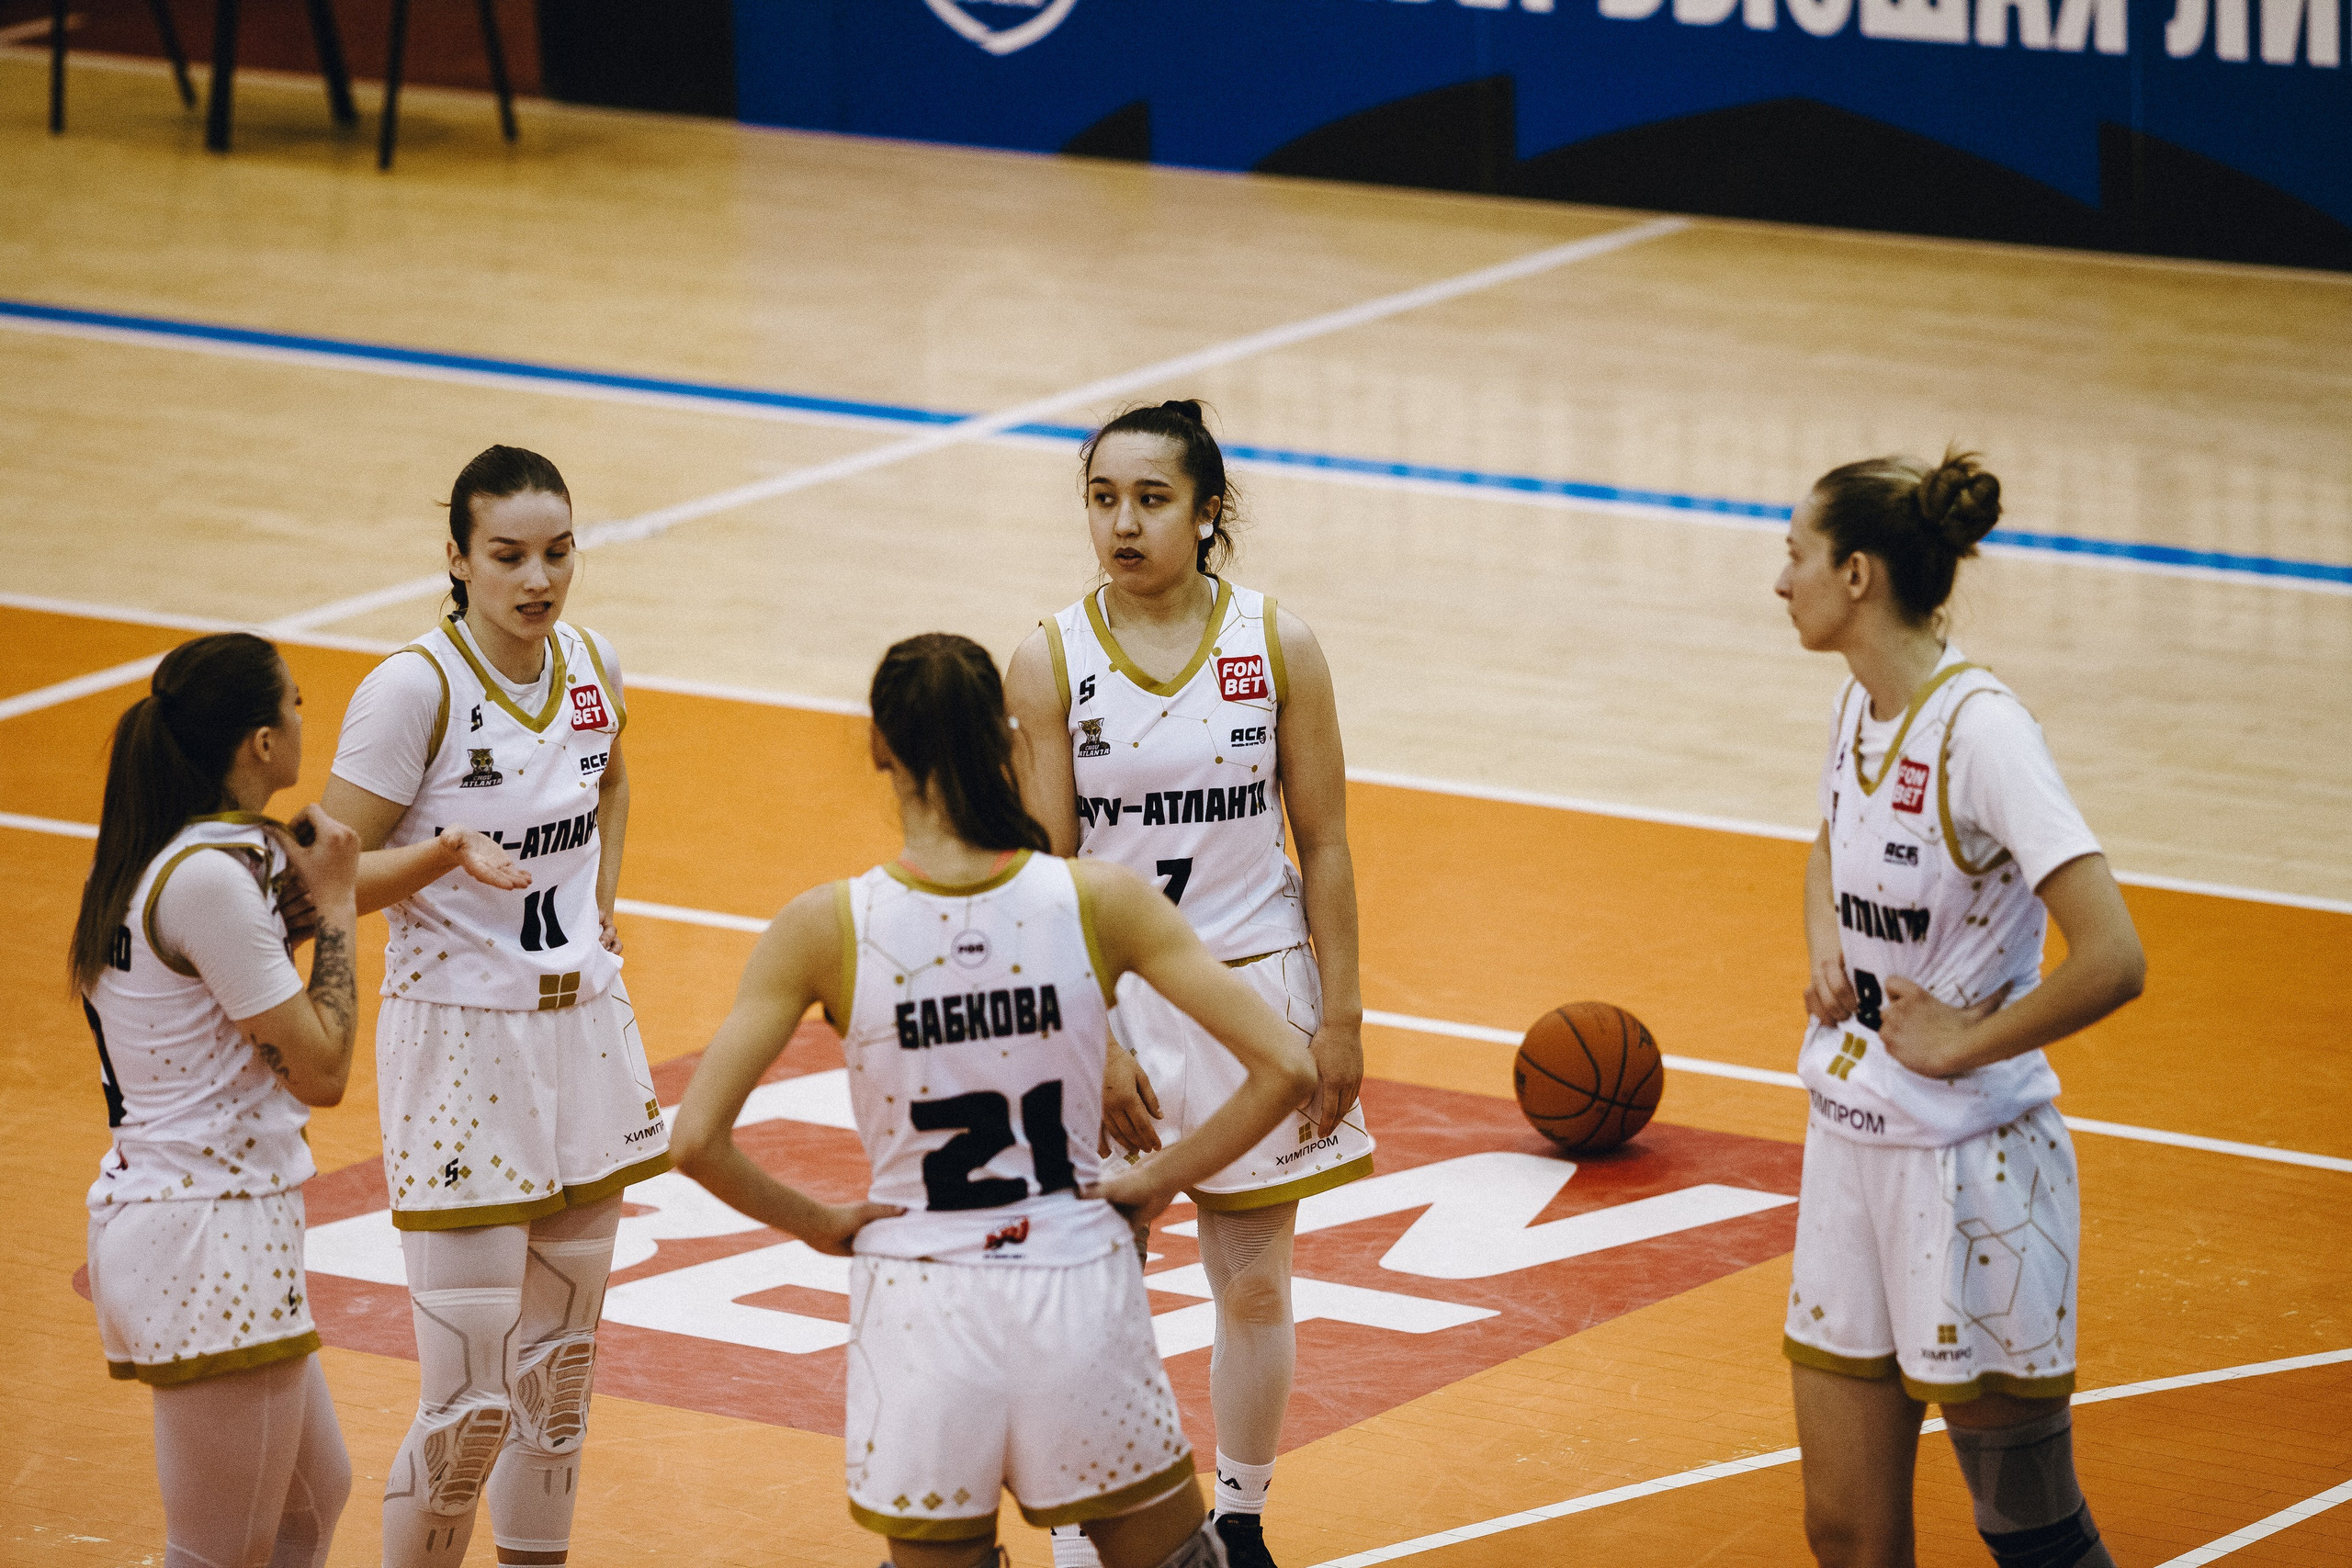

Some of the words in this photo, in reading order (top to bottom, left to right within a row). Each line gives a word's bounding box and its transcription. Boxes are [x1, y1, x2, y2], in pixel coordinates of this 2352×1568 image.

[1223, 660, 1261, 678] FON
[1225, 676, 1263, 695] BET
[573, 706, 602, 725] BET
[462, 778, 503, 787] ATLANTA
[1157, 857, 1193, 907] 7
[521, 885, 569, 952] 11
[896, 985, 1062, 1049] БАБКОВА
[910, 1080, 1079, 1211] 21
[1275, 1135, 1339, 1166] ХИМПРОМ
